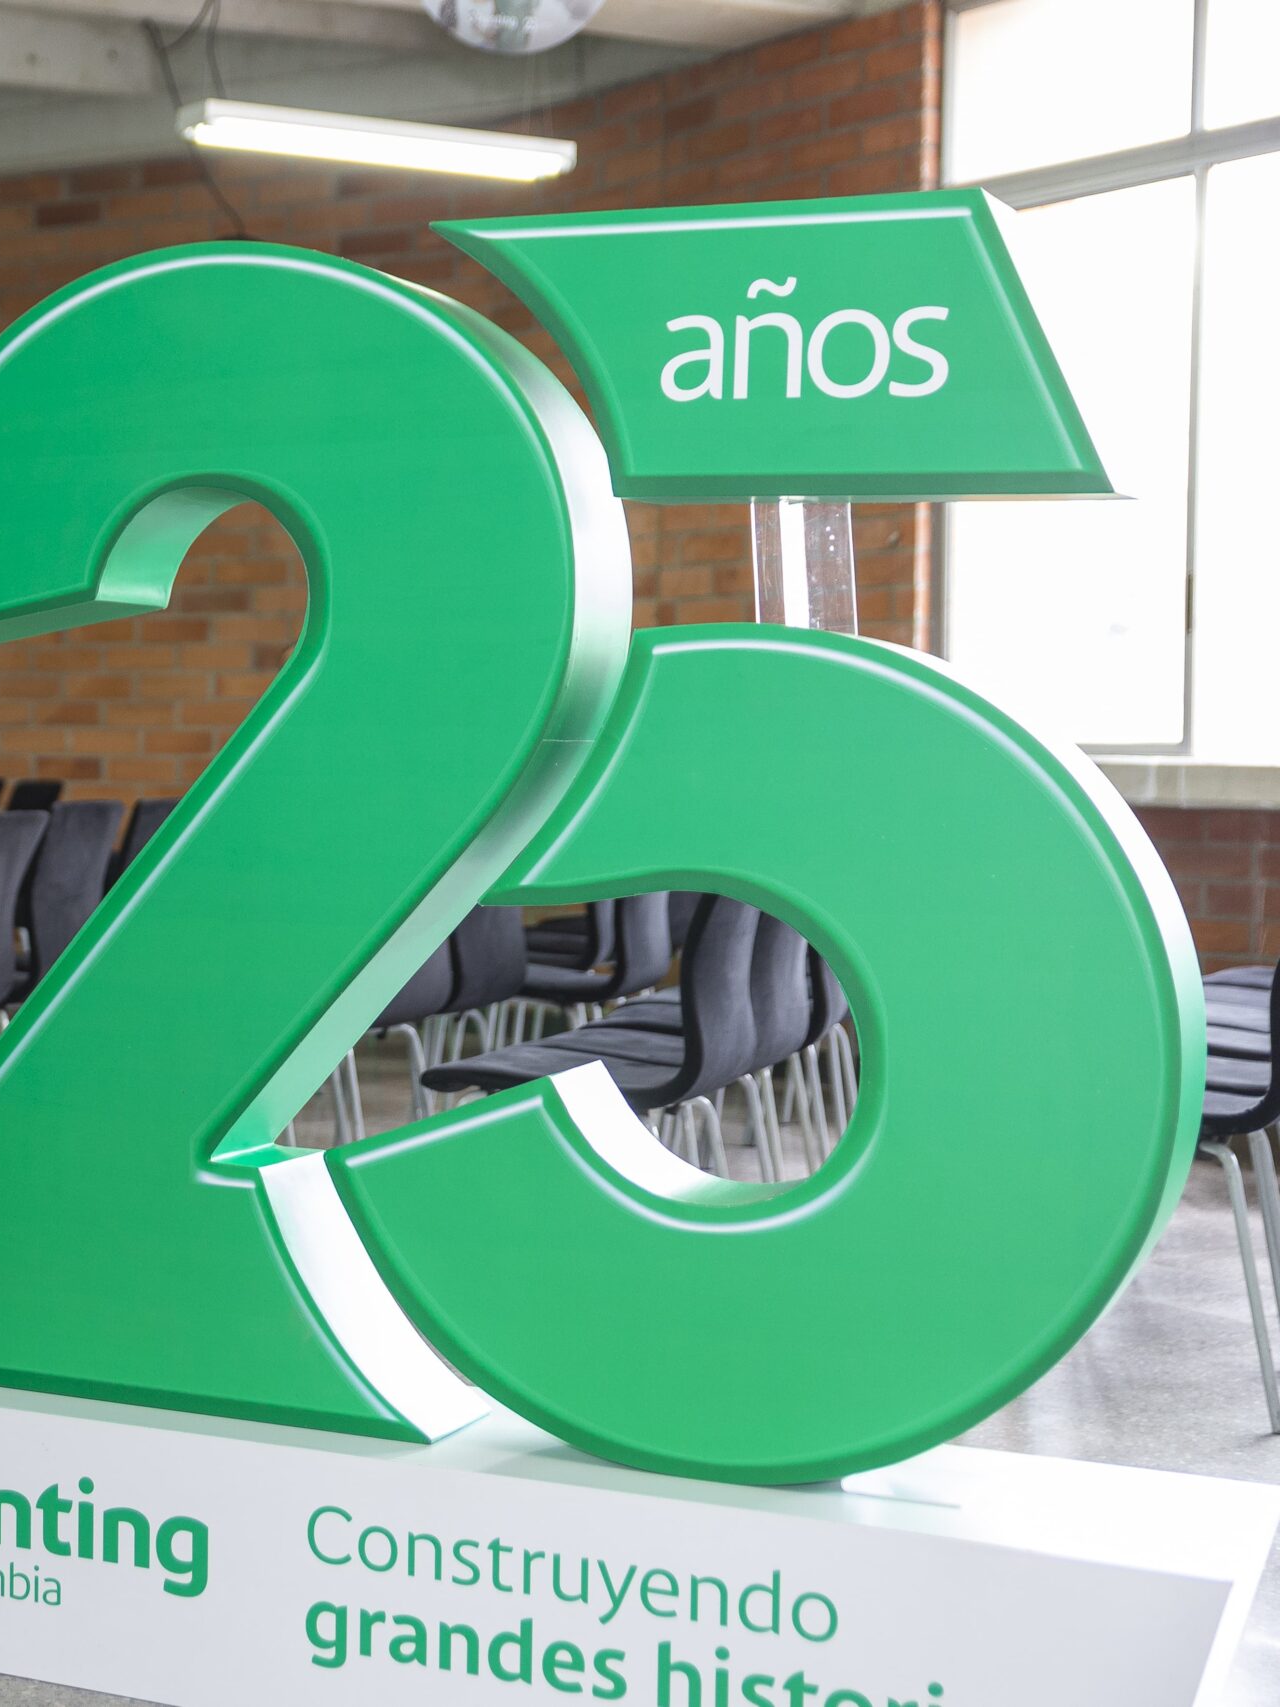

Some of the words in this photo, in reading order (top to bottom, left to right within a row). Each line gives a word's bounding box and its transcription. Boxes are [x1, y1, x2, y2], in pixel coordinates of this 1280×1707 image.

[660, 276, 950, 402] años
[306, 1505, 839, 1644] Construyendo
[304, 1600, 628, 1701] grandes
[656, 1640, 946, 1707] hist
